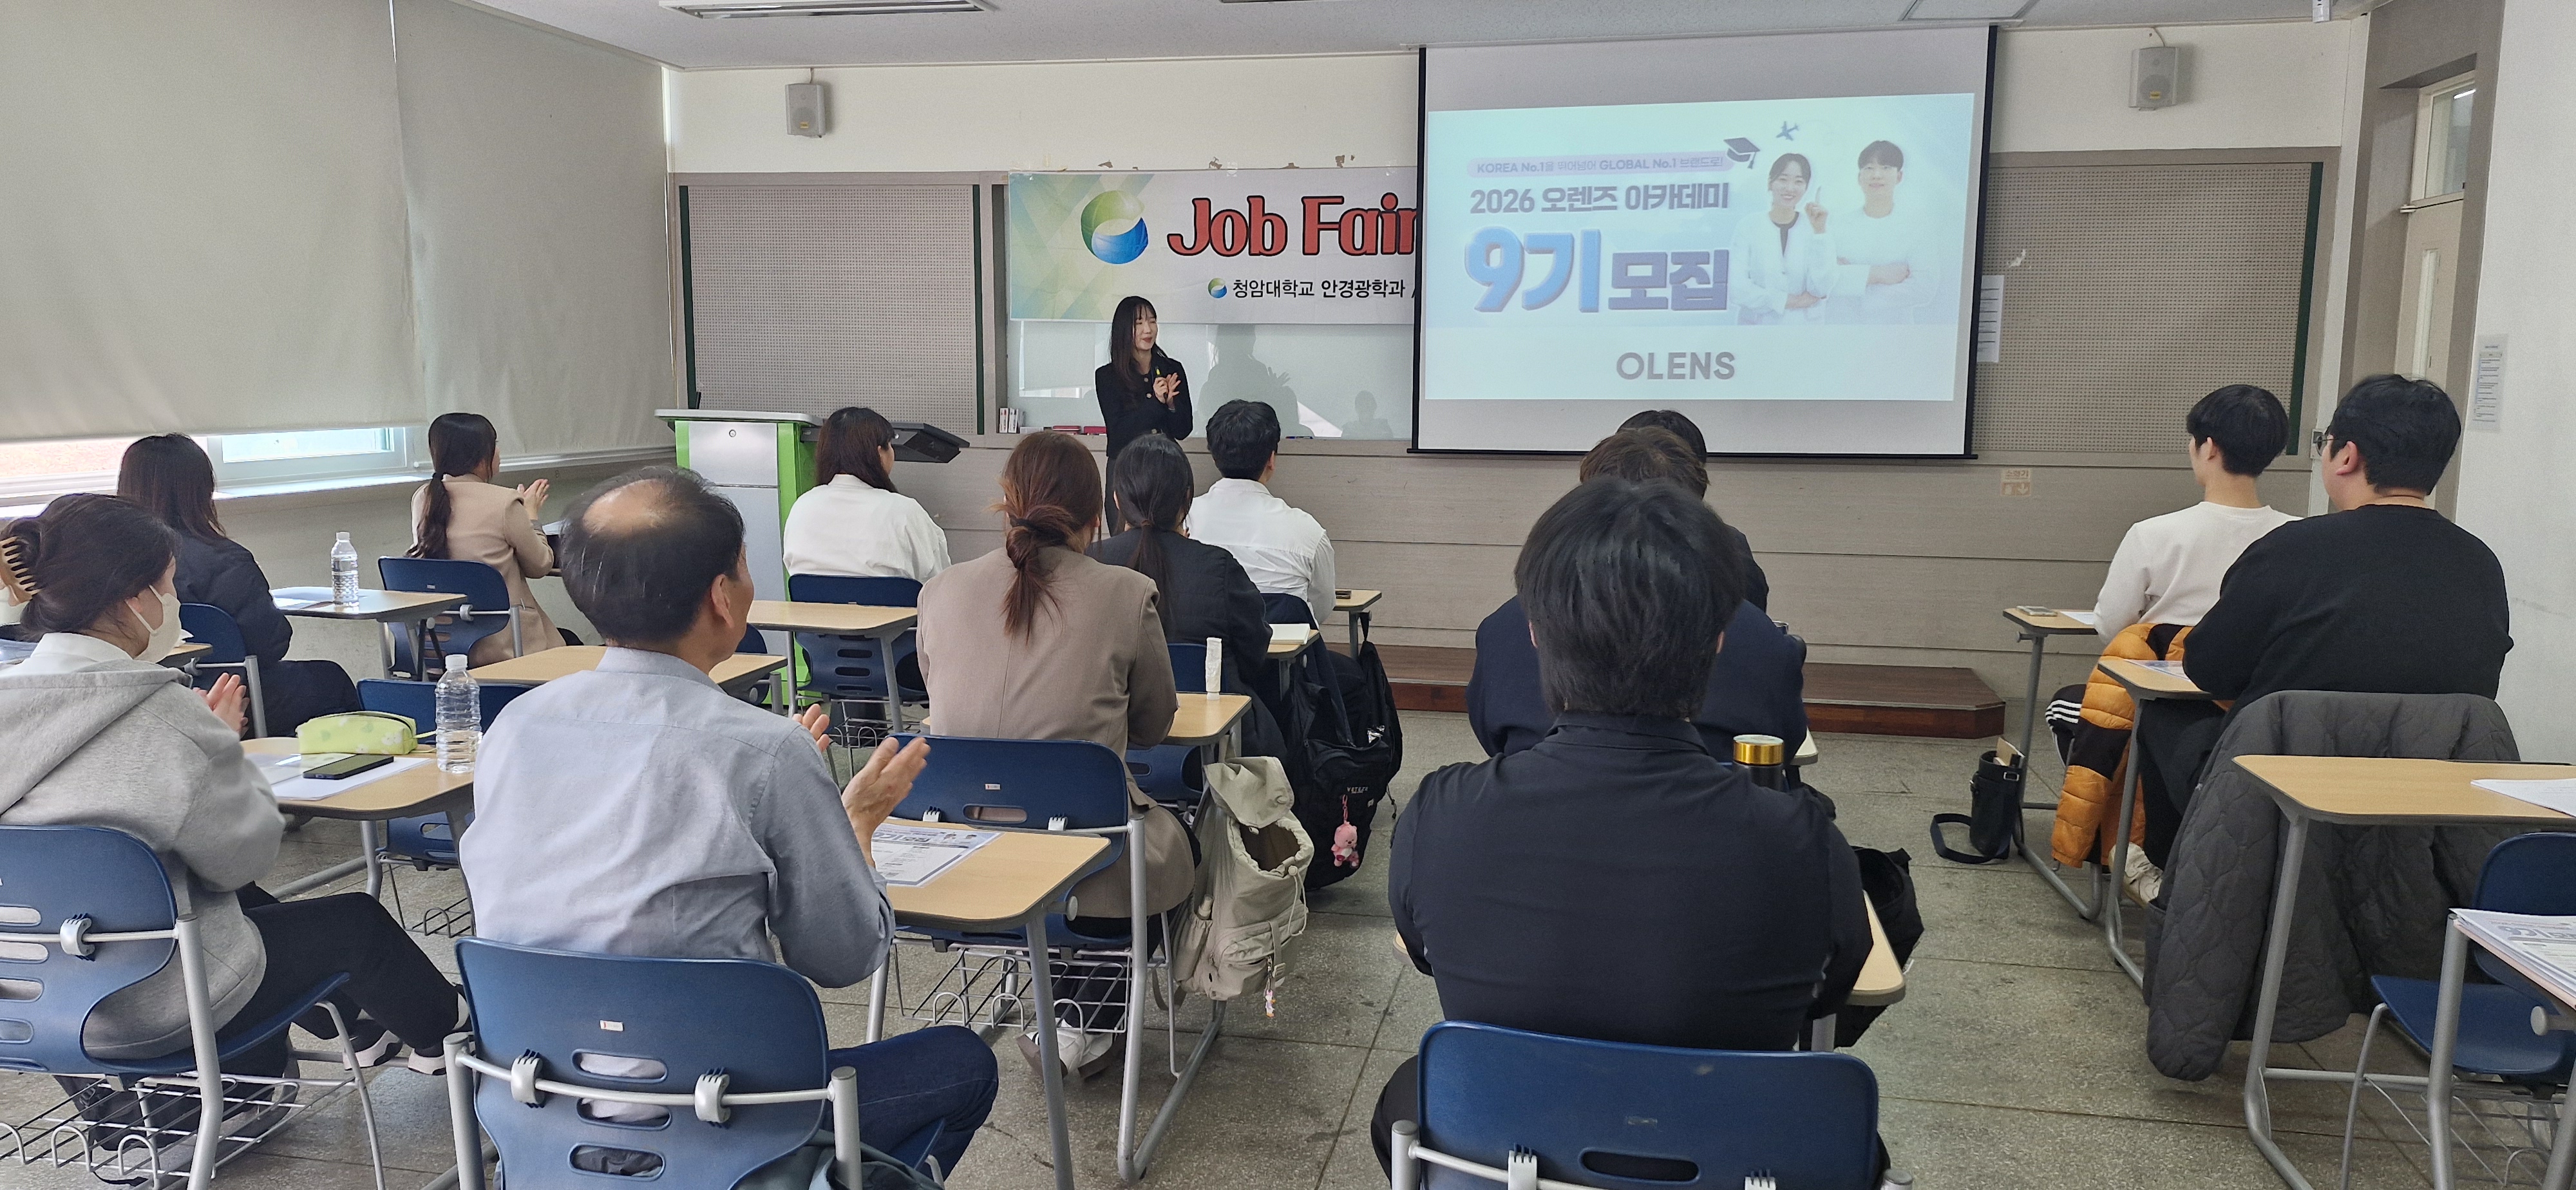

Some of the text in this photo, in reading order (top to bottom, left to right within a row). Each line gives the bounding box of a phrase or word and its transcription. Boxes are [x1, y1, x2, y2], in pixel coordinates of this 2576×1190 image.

[1477, 163, 1518, 173] KOREA
[1521, 161, 1554, 172] No.1을
[1558, 160, 1596, 171] 뛰어넘어
[1599, 159, 1649, 170] GLOBAL
[1653, 158, 1676, 169] No.1
[1470, 182, 1729, 214] 2026 오렌즈 아카데미
[1167, 192, 1417, 257] Job Fair
[1464, 226, 1730, 314] 9기 모집
[1232, 279, 1315, 299] 청암대학교
[1321, 279, 1406, 299] 안경광학과
[1616, 352, 1736, 380] OLENS
